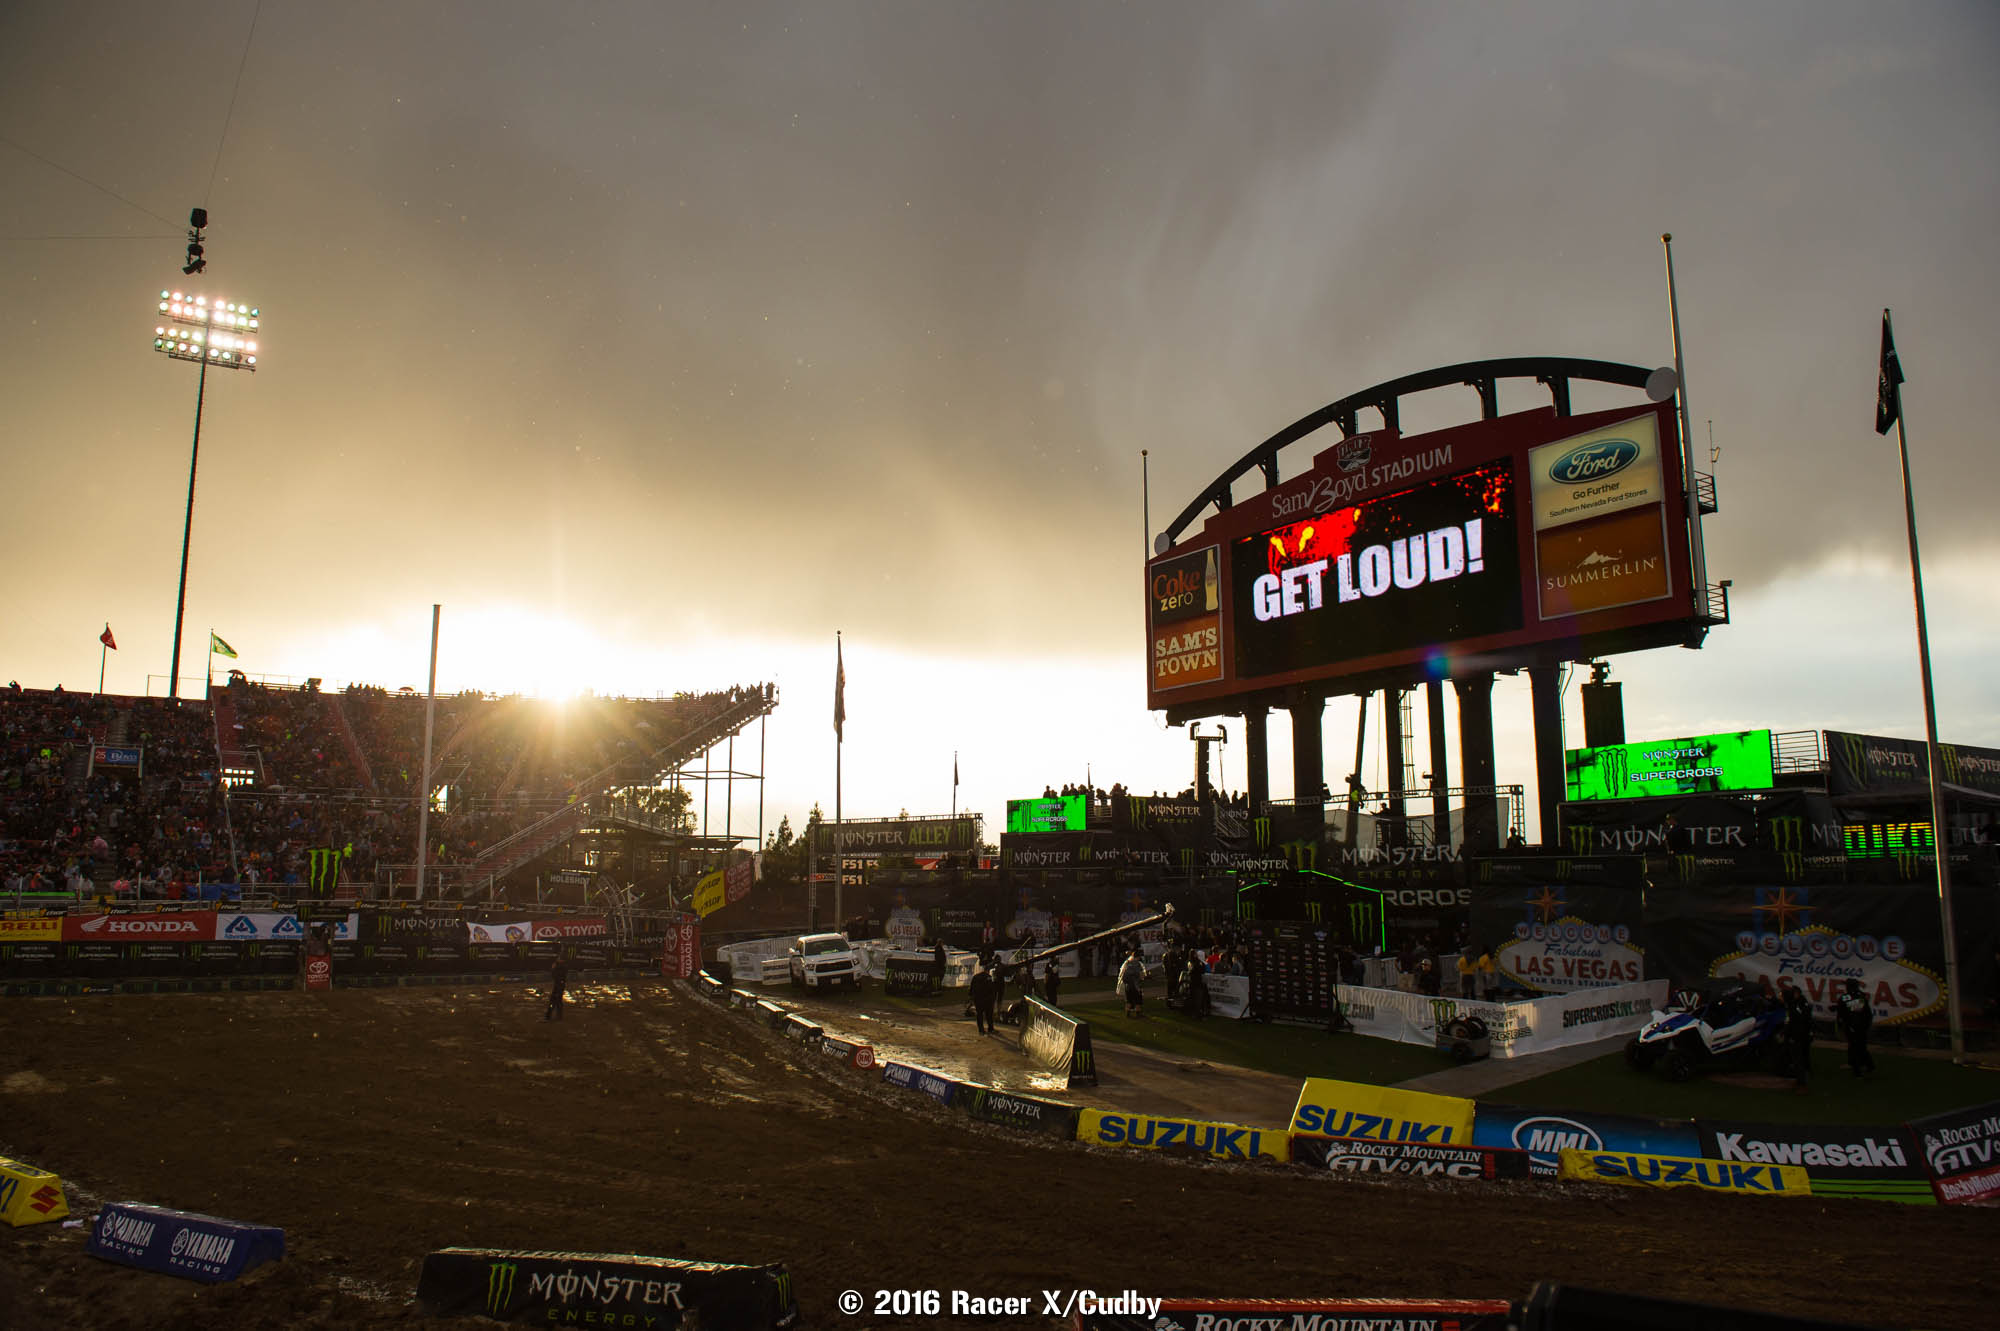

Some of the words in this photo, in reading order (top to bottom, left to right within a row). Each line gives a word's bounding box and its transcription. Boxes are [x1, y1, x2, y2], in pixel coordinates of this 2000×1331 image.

[1566, 446, 1621, 480] Ford
[1272, 491, 1310, 519] Sam
[1307, 467, 1368, 513] Boyd
[1371, 444, 1453, 486] STADIUM
[1572, 490, 1586, 500] Go
[1587, 482, 1620, 497] Further
[1549, 504, 1580, 518] Southern
[1580, 499, 1607, 511] Nevada
[1607, 494, 1624, 505] Ford
[1624, 488, 1648, 500] Stores
[1252, 558, 1329, 622] GET
[1336, 517, 1485, 604] LOUD!
[1546, 557, 1656, 590] SUMMERLIN
[1153, 568, 1201, 601] Coke
[1160, 591, 1194, 612] zero
[1155, 626, 1218, 658] SAM'S
[1156, 647, 1218, 677] TOWN
[1866, 745, 1918, 768] MONSTER
[1630, 767, 1724, 782] SUPERCROSS
[1148, 802, 1201, 817] MONSTER
[833, 828, 904, 847] MONSTER
[908, 824, 951, 846] ALLEY
[1600, 824, 1748, 852] MONTER
[842, 858, 863, 870] FS1
[1014, 848, 1072, 866] MONSTER
[1237, 857, 1289, 872] MONSTER
[1342, 843, 1464, 868] MONSTER
[842, 874, 863, 886] FS1
[108, 921, 199, 932] HONDA
[1516, 925, 1627, 941] WELCOME
[1544, 943, 1602, 958] Fabulous
[1738, 935, 1902, 956] WELCOME
[1515, 955, 1554, 977] LAS
[1562, 957, 1639, 982] VEGAS
[1778, 958, 1864, 978] Fabulous
[987, 1094, 1041, 1120] MONSTER
[1295, 1104, 1454, 1144] SUZUKI
[1938, 1123, 1982, 1146] ROCKY
[1097, 1115, 1261, 1160] SUZUKI
[1529, 1128, 1589, 1152] MMI
[1350, 1141, 1399, 1158] ROCKY
[1400, 1145, 1482, 1163] MOUNTAIN
[1716, 1132, 1908, 1168] Kawasaki
[1934, 1138, 1993, 1176] ATV
[1591, 1154, 1786, 1191] SUZUKI
[112, 1215, 156, 1248] YAMAHA
[100, 1238, 144, 1256] RACING
[184, 1231, 236, 1265] YAMAHA
[169, 1256, 222, 1275] RACING
[530, 1269, 685, 1310] MONSTER
[547, 1308, 657, 1328] ENERGY
[1194, 1313, 1285, 1331] ROCKY
[1291, 1313, 1437, 1331] MOUNTAIN
